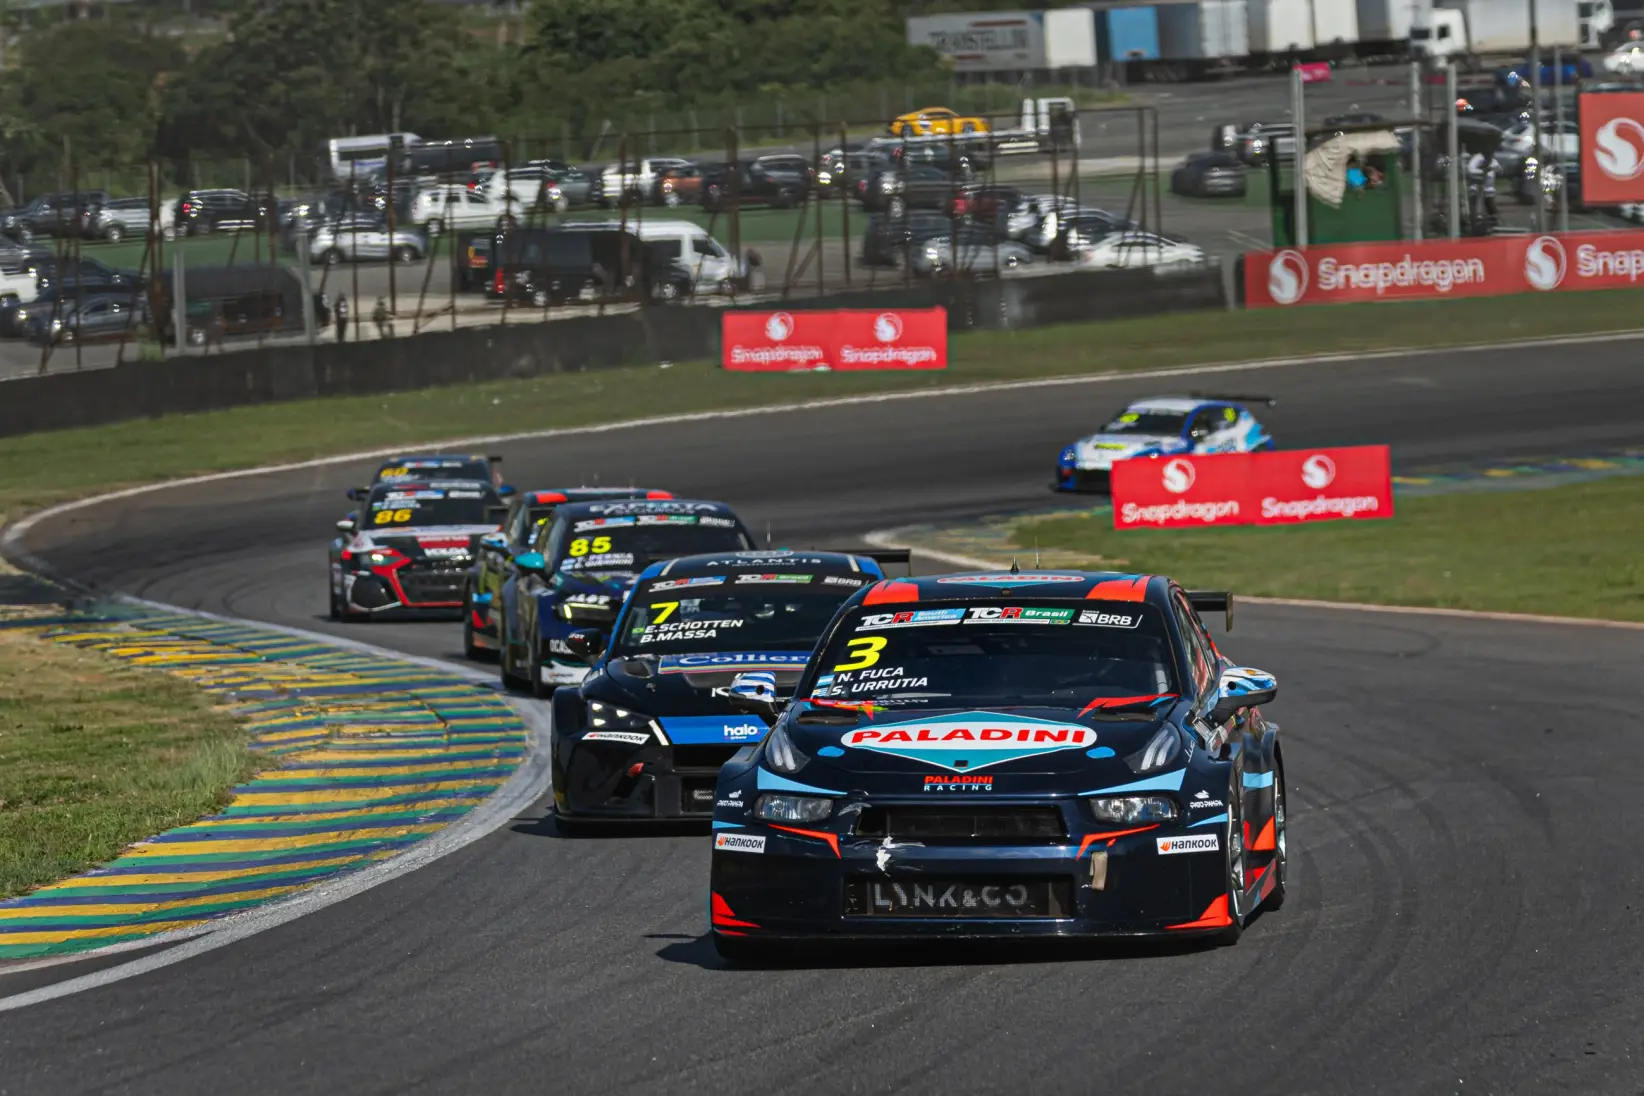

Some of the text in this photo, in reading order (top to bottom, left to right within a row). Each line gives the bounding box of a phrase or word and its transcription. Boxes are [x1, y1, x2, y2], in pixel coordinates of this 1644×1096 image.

[1317, 254, 1485, 294] Snapdragon
[730, 344, 824, 365] Snapdragon
[840, 344, 937, 365] Snapdragon
[1121, 499, 1239, 525] Snapdragon
[1261, 495, 1379, 520] Snapdragon
[568, 536, 612, 557] 85
[706, 558, 822, 567] ATLANTIS
[938, 575, 1083, 583] PALADINI
[650, 601, 679, 625] 7
[860, 611, 915, 627] TCR
[969, 606, 1068, 619] TCR Brasil
[1097, 613, 1133, 626] BRB
[639, 629, 717, 644] B.MASSA
[833, 636, 888, 672] 3
[837, 667, 904, 683] N. FUCA
[831, 677, 928, 696] S. URRUTIA
[851, 728, 1086, 744] PALADINI
[924, 775, 994, 784] PALADINI
